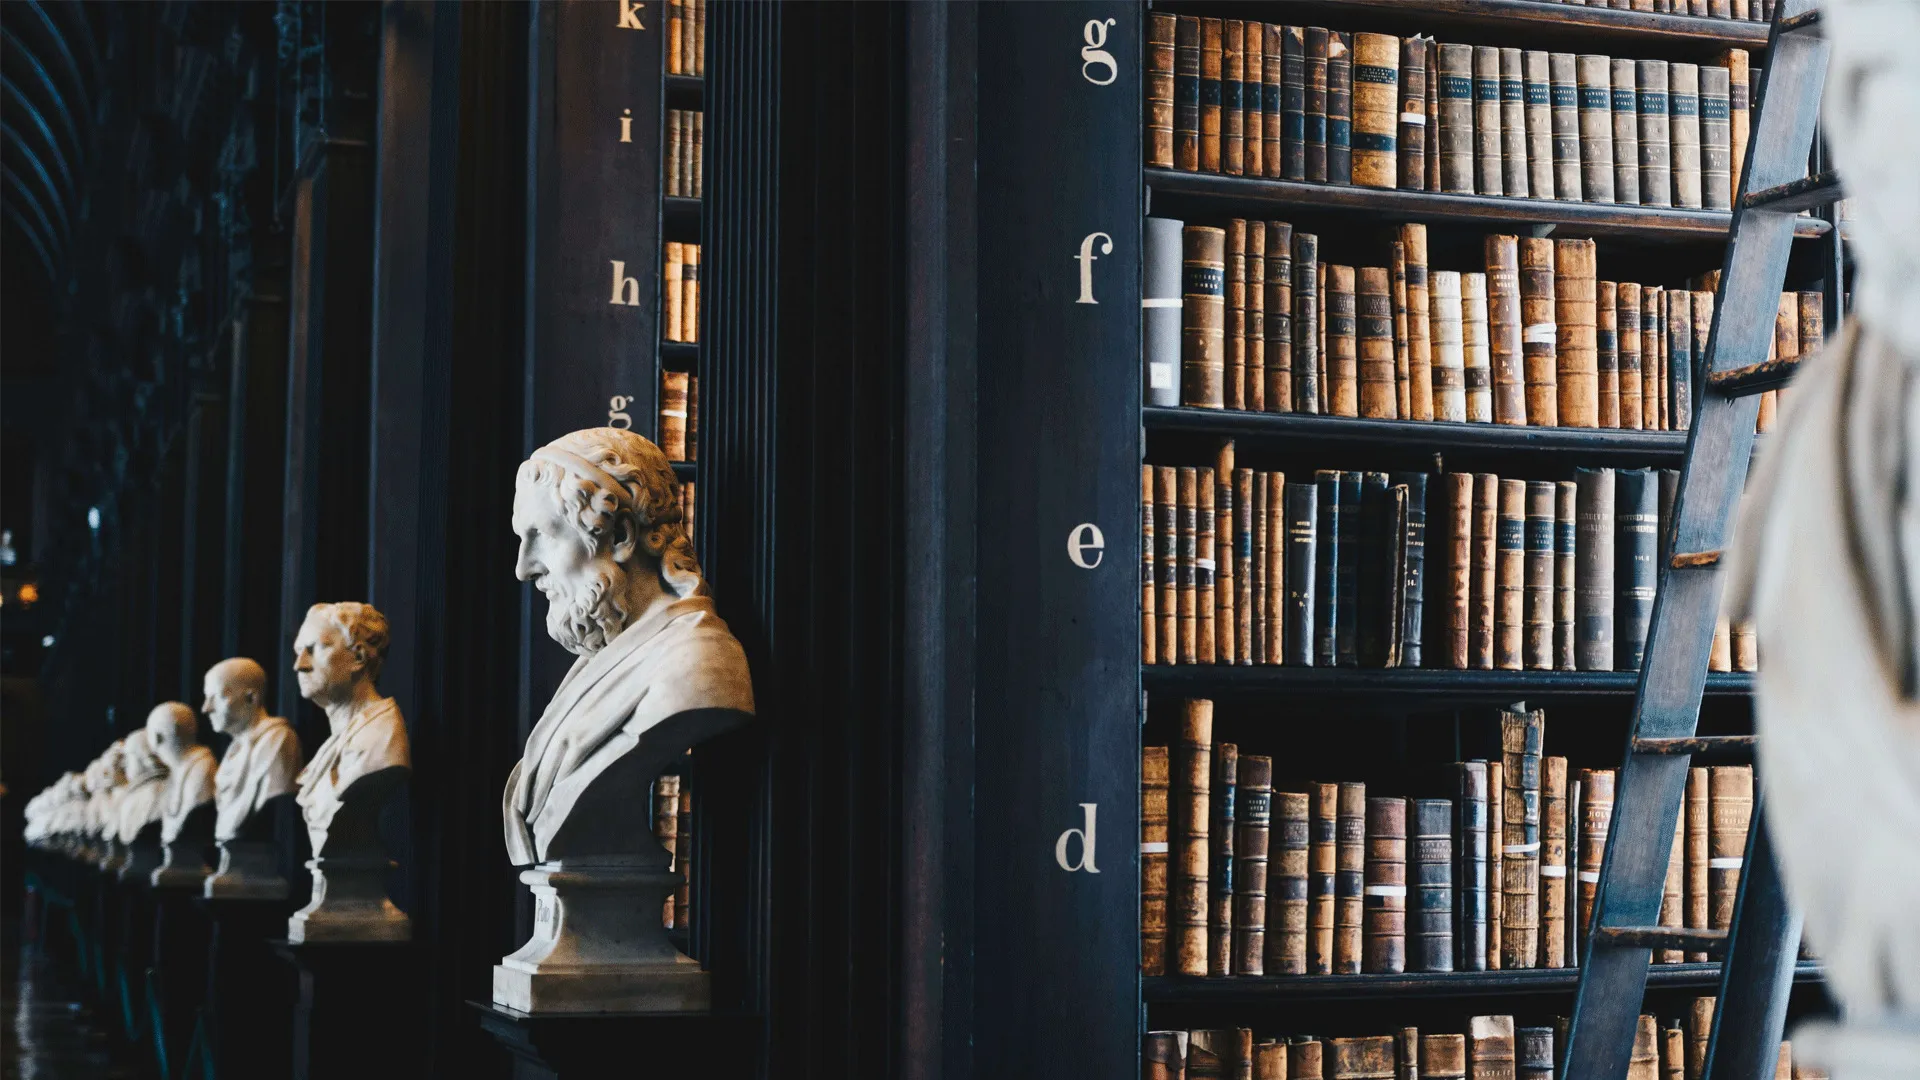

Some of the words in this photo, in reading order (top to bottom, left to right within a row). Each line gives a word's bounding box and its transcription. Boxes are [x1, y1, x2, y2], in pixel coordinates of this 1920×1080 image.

[617, 0, 645, 29] k
[1082, 18, 1117, 86] g
[620, 109, 633, 142] i
[609, 260, 640, 306] h
[1074, 232, 1113, 304] f
[607, 396, 634, 429] g
[1068, 523, 1104, 569] e
[1056, 803, 1100, 873] d
